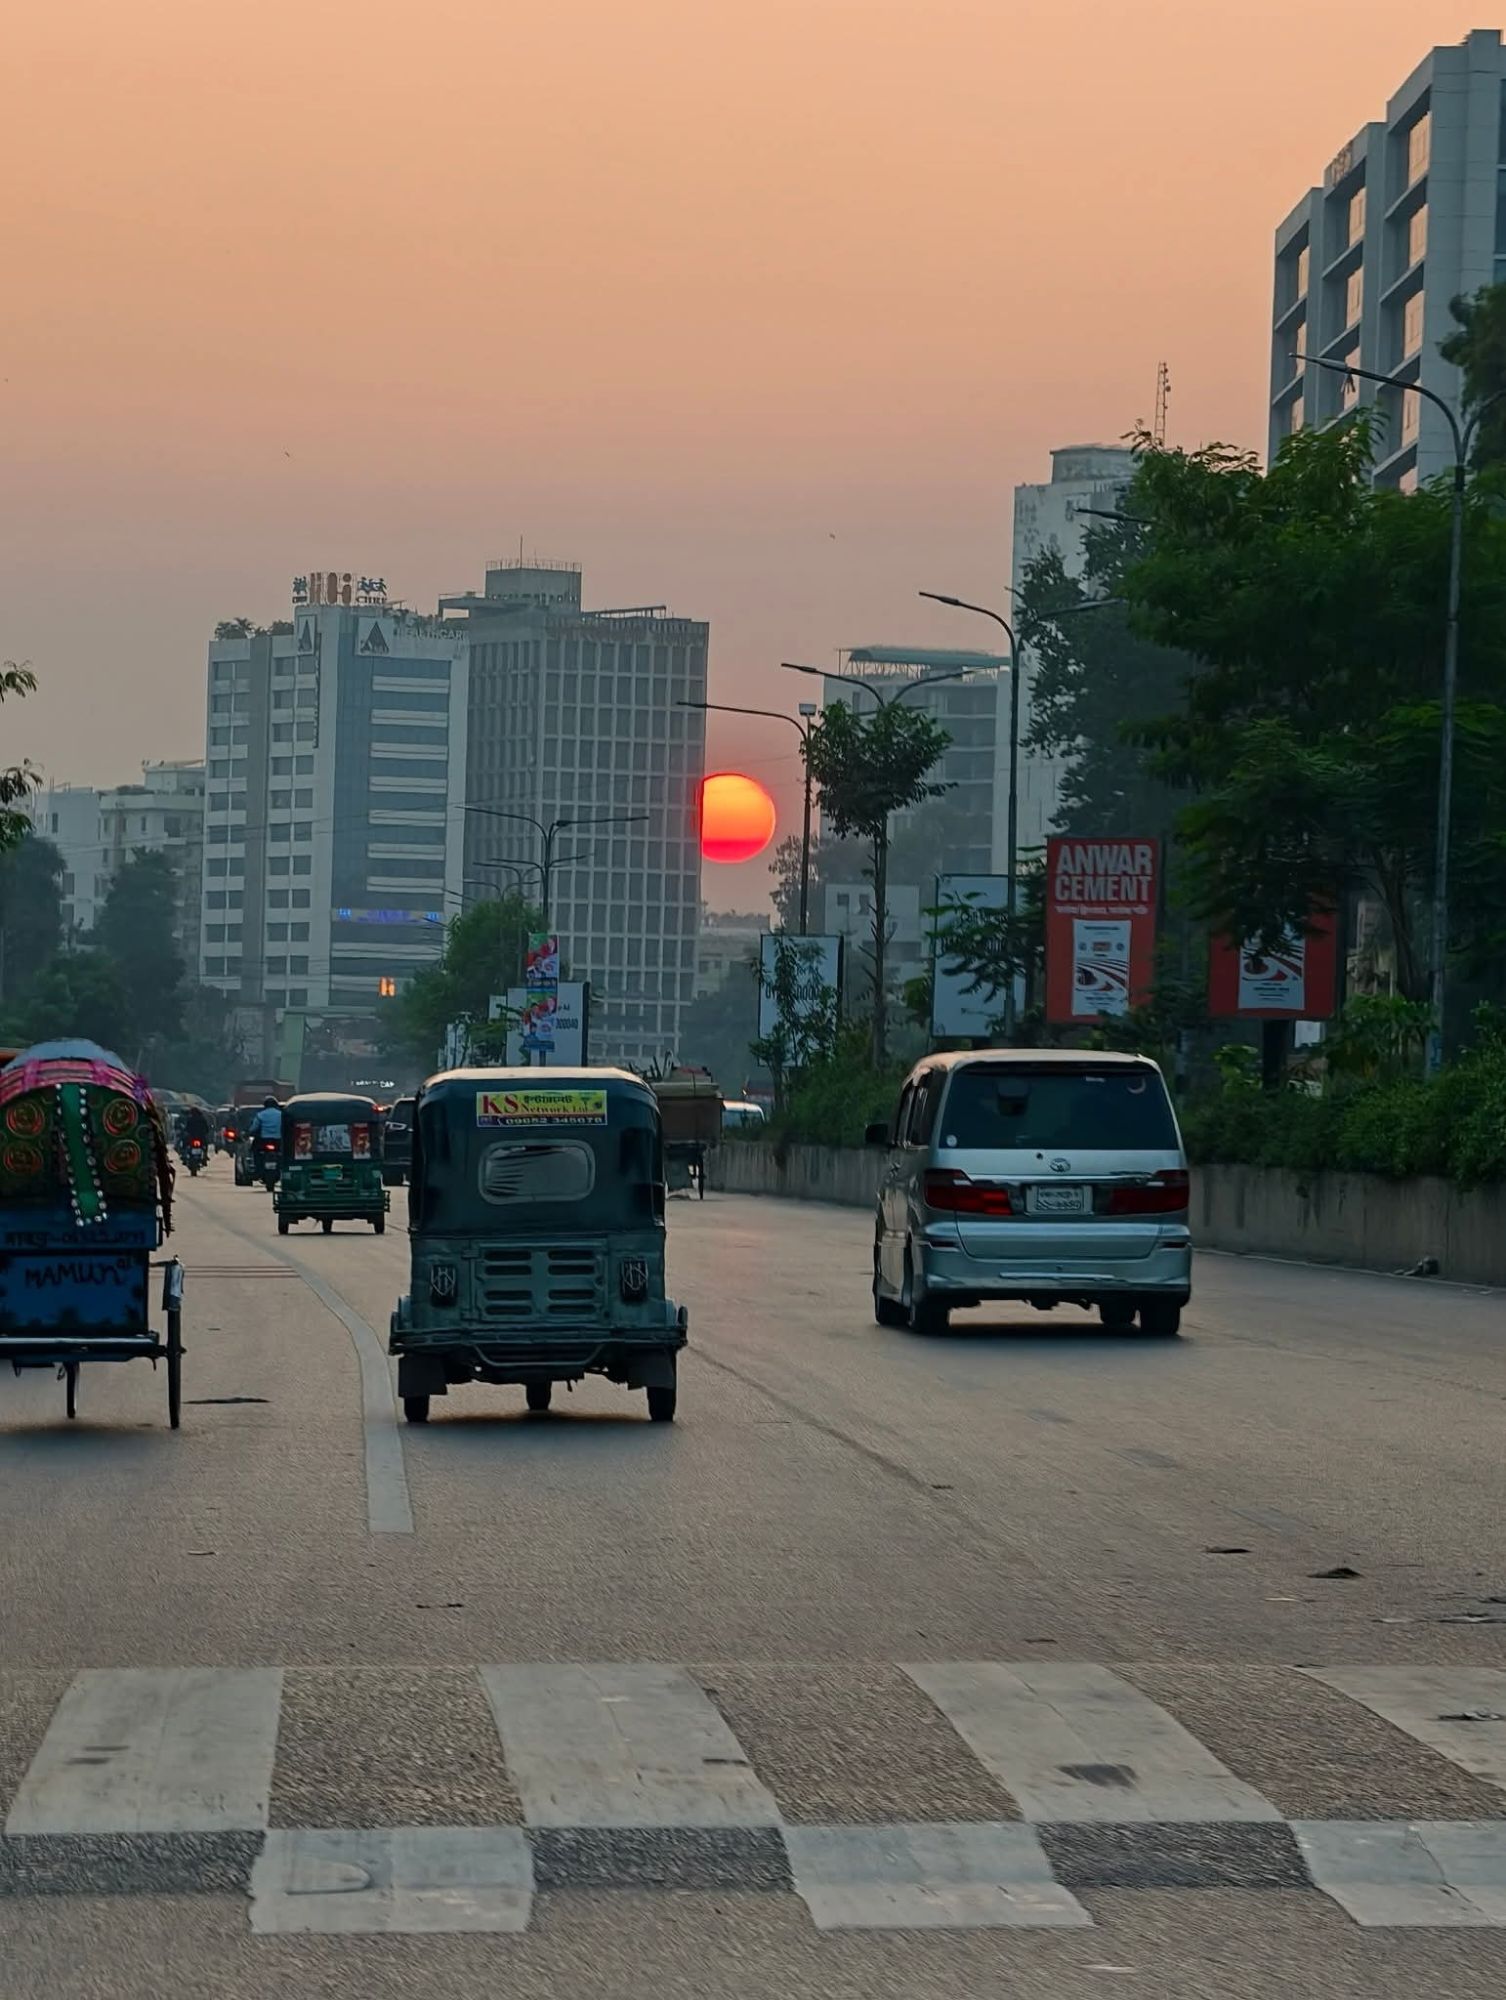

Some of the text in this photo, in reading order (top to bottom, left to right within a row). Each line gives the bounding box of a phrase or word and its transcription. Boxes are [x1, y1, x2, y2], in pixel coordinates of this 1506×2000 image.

[1056, 844, 1153, 875] ANWAR
[1055, 874, 1151, 902] CEMENT
[483, 1093, 518, 1114] KS
[521, 1102, 569, 1113] Network
